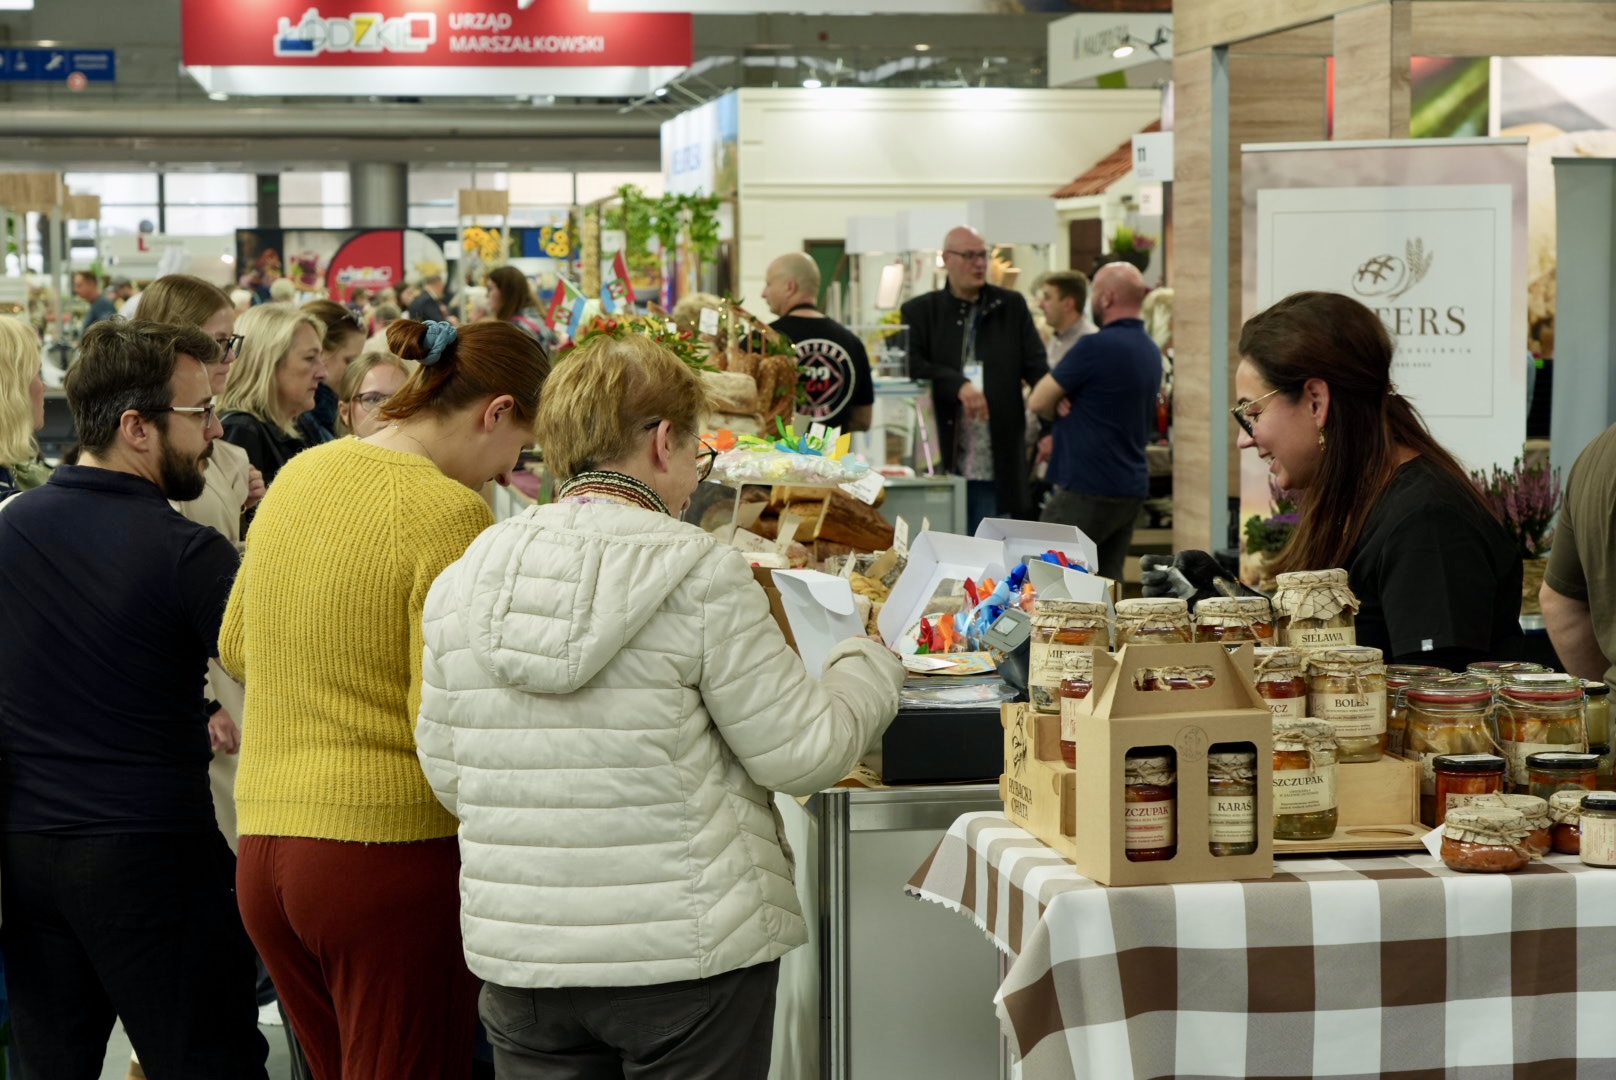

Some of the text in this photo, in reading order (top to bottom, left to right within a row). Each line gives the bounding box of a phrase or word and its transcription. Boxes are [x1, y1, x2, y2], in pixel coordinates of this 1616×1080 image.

[449, 13, 512, 33] URZĄD
[449, 36, 605, 53] MARSZAŁKOWSKI
[1301, 632, 1344, 643] SIELAWA
[1272, 775, 1324, 787] SZCZUPAK
[1217, 800, 1252, 811] KARAŚ
